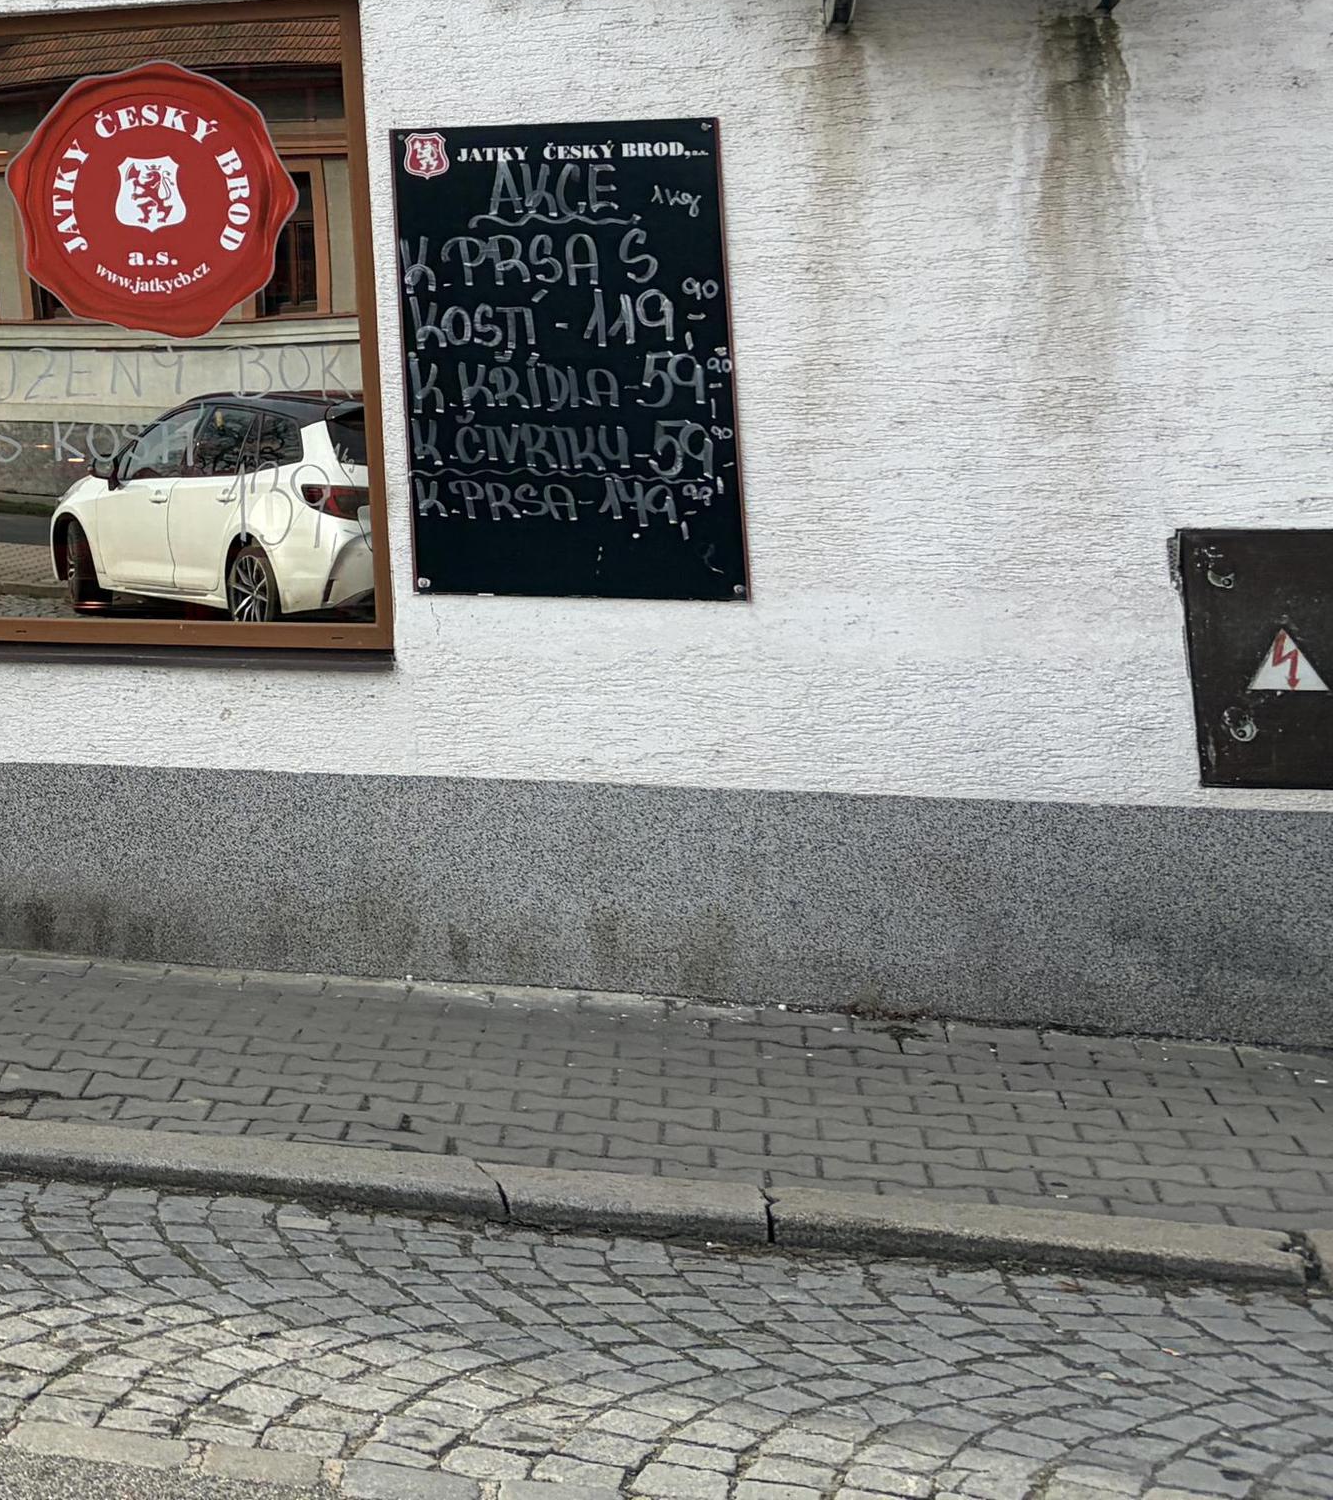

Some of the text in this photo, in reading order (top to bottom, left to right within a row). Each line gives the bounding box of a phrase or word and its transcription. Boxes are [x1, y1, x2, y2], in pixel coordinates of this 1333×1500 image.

[457, 146, 528, 162] JATKY
[543, 140, 614, 160] ČESKÝ
[52, 104, 251, 253] JATKY ČESKÝ BROD
[489, 160, 620, 217] AKCE
[95, 262, 211, 294] www.jatkycb.cz
[128, 251, 178, 266] a.s.
[225, 344, 354, 400] BOK
